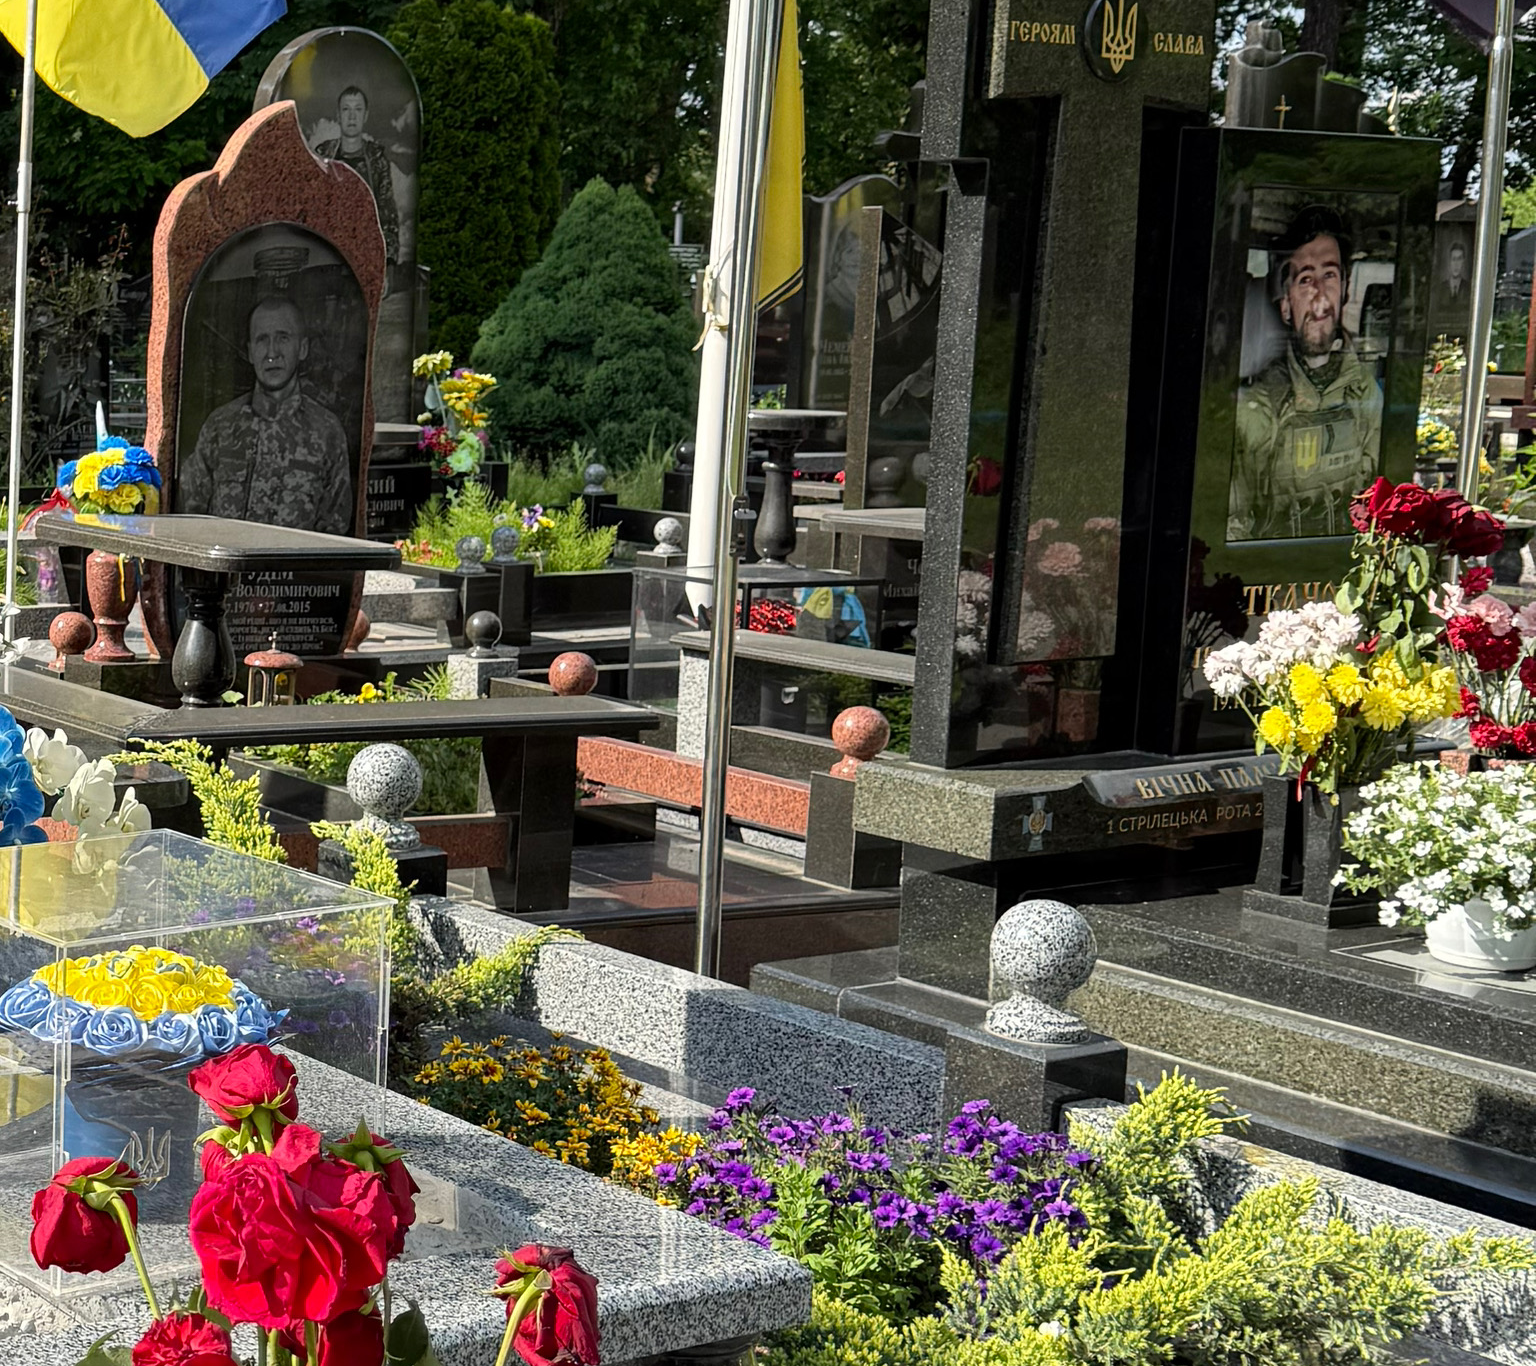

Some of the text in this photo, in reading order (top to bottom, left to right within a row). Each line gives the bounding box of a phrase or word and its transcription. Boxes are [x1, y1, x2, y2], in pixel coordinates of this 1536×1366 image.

[1010, 21, 1205, 55] ГЕРОЯМ СЛАВА
[1135, 771, 1215, 800] ВІЧНА
[1106, 818, 1114, 835] 1
[1119, 808, 1208, 833] СТРІЛЕЦЬКА
[1216, 804, 1252, 821] РОТА
